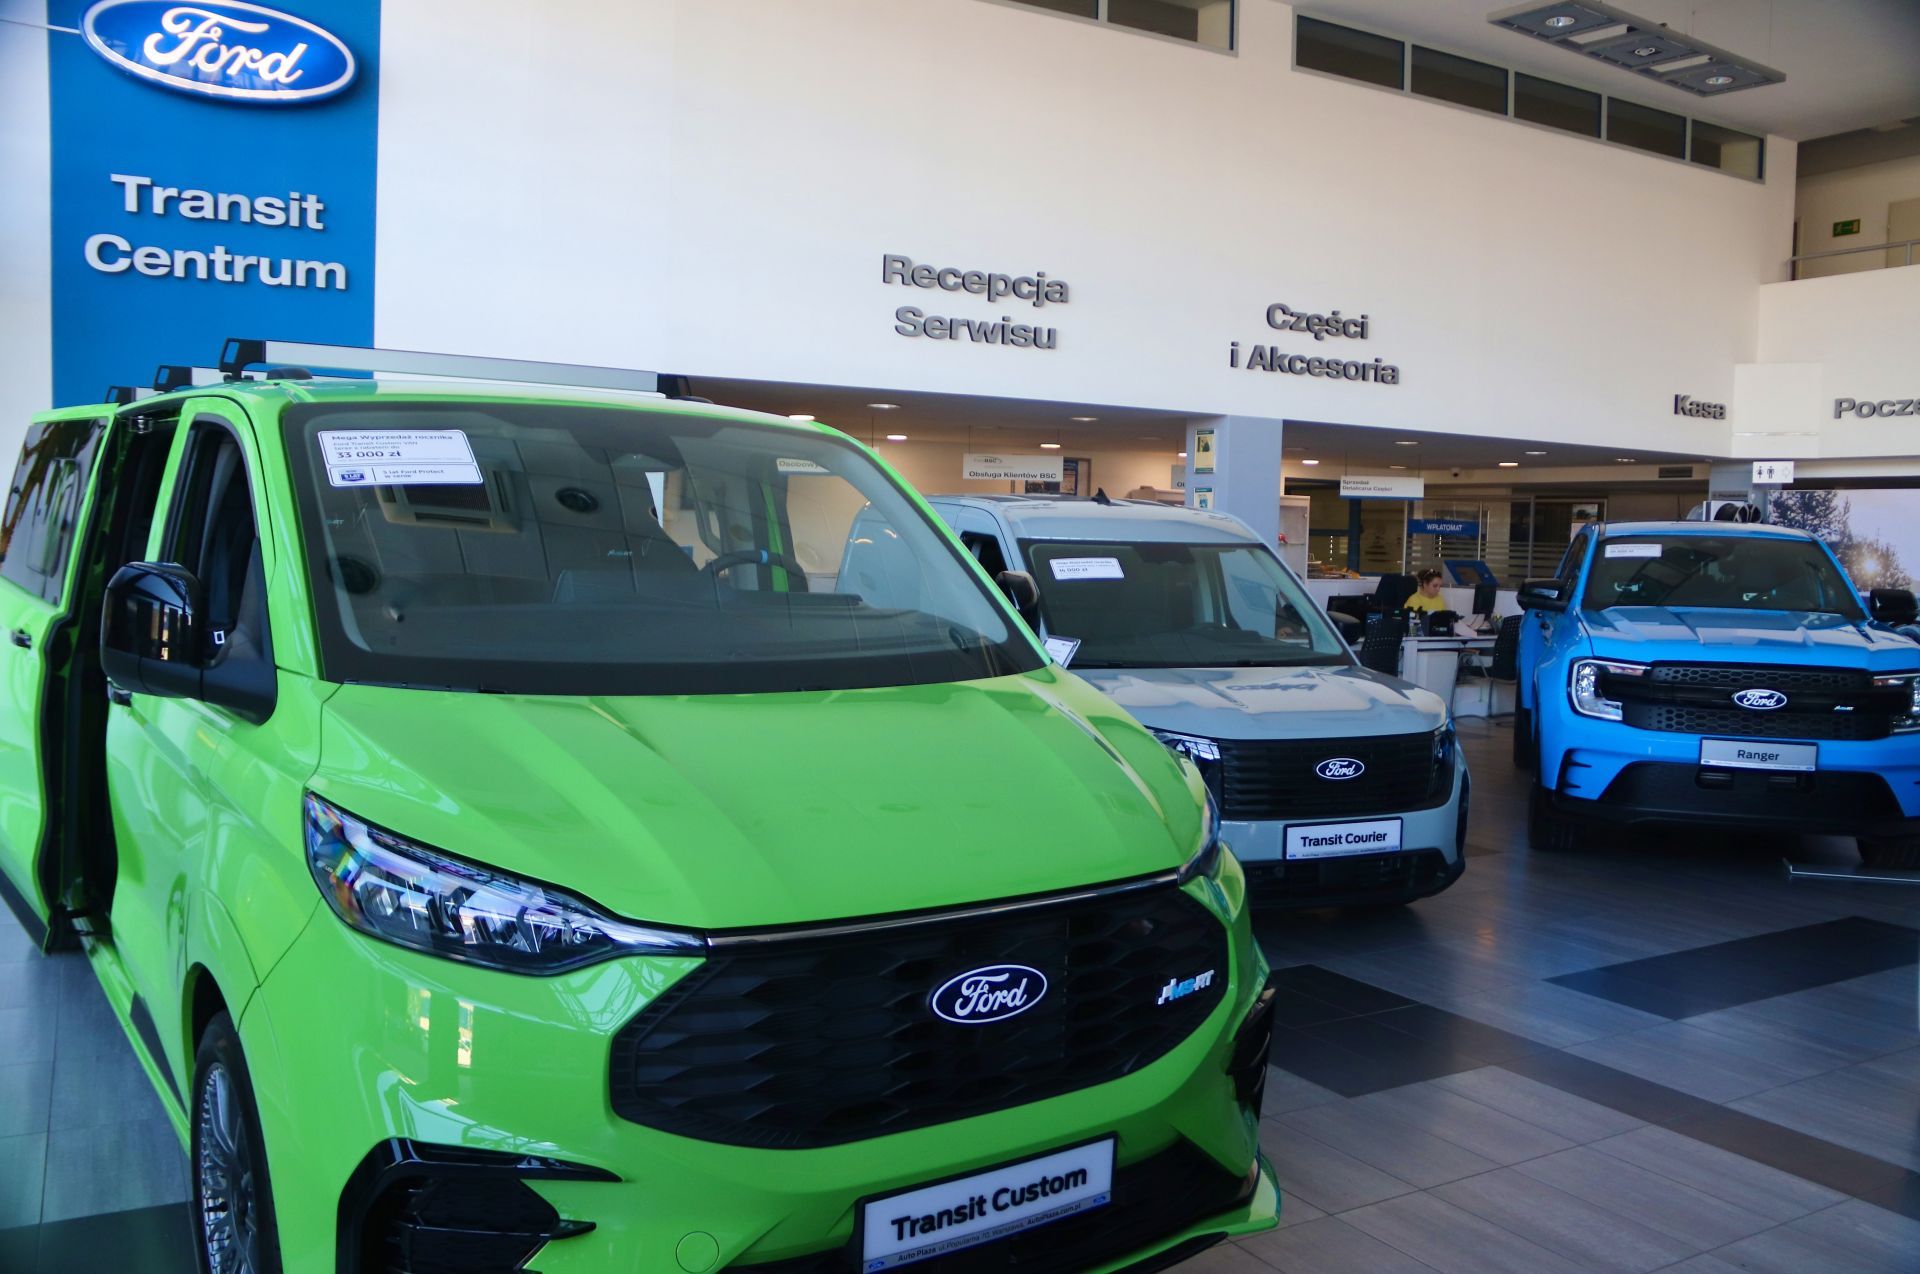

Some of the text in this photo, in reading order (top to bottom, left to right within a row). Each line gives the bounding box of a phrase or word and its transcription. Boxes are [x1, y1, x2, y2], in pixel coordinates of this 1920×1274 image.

[144, 7, 308, 84] Ford
[110, 173, 325, 230] Transit
[84, 233, 347, 291] Centrum
[882, 253, 1070, 308] Recepcja
[894, 305, 1057, 350] Serwisu
[1266, 302, 1369, 341] Części
[1230, 341, 1400, 385] i Akcesoria
[1673, 393, 1727, 420] Kasa
[356, 450, 384, 458] 000
[969, 470, 1002, 479] Obsługa
[1003, 471, 1038, 479] Klientów
[1426, 523, 1462, 531] WPŁATOMAT
[1743, 691, 1778, 708] Ford
[1325, 760, 1356, 776] Ford
[1737, 749, 1780, 762] Ranger
[1300, 831, 1388, 848] Transit Courier
[954, 972, 1028, 1018] Ford
[890, 1167, 1088, 1241] Transit Custom
